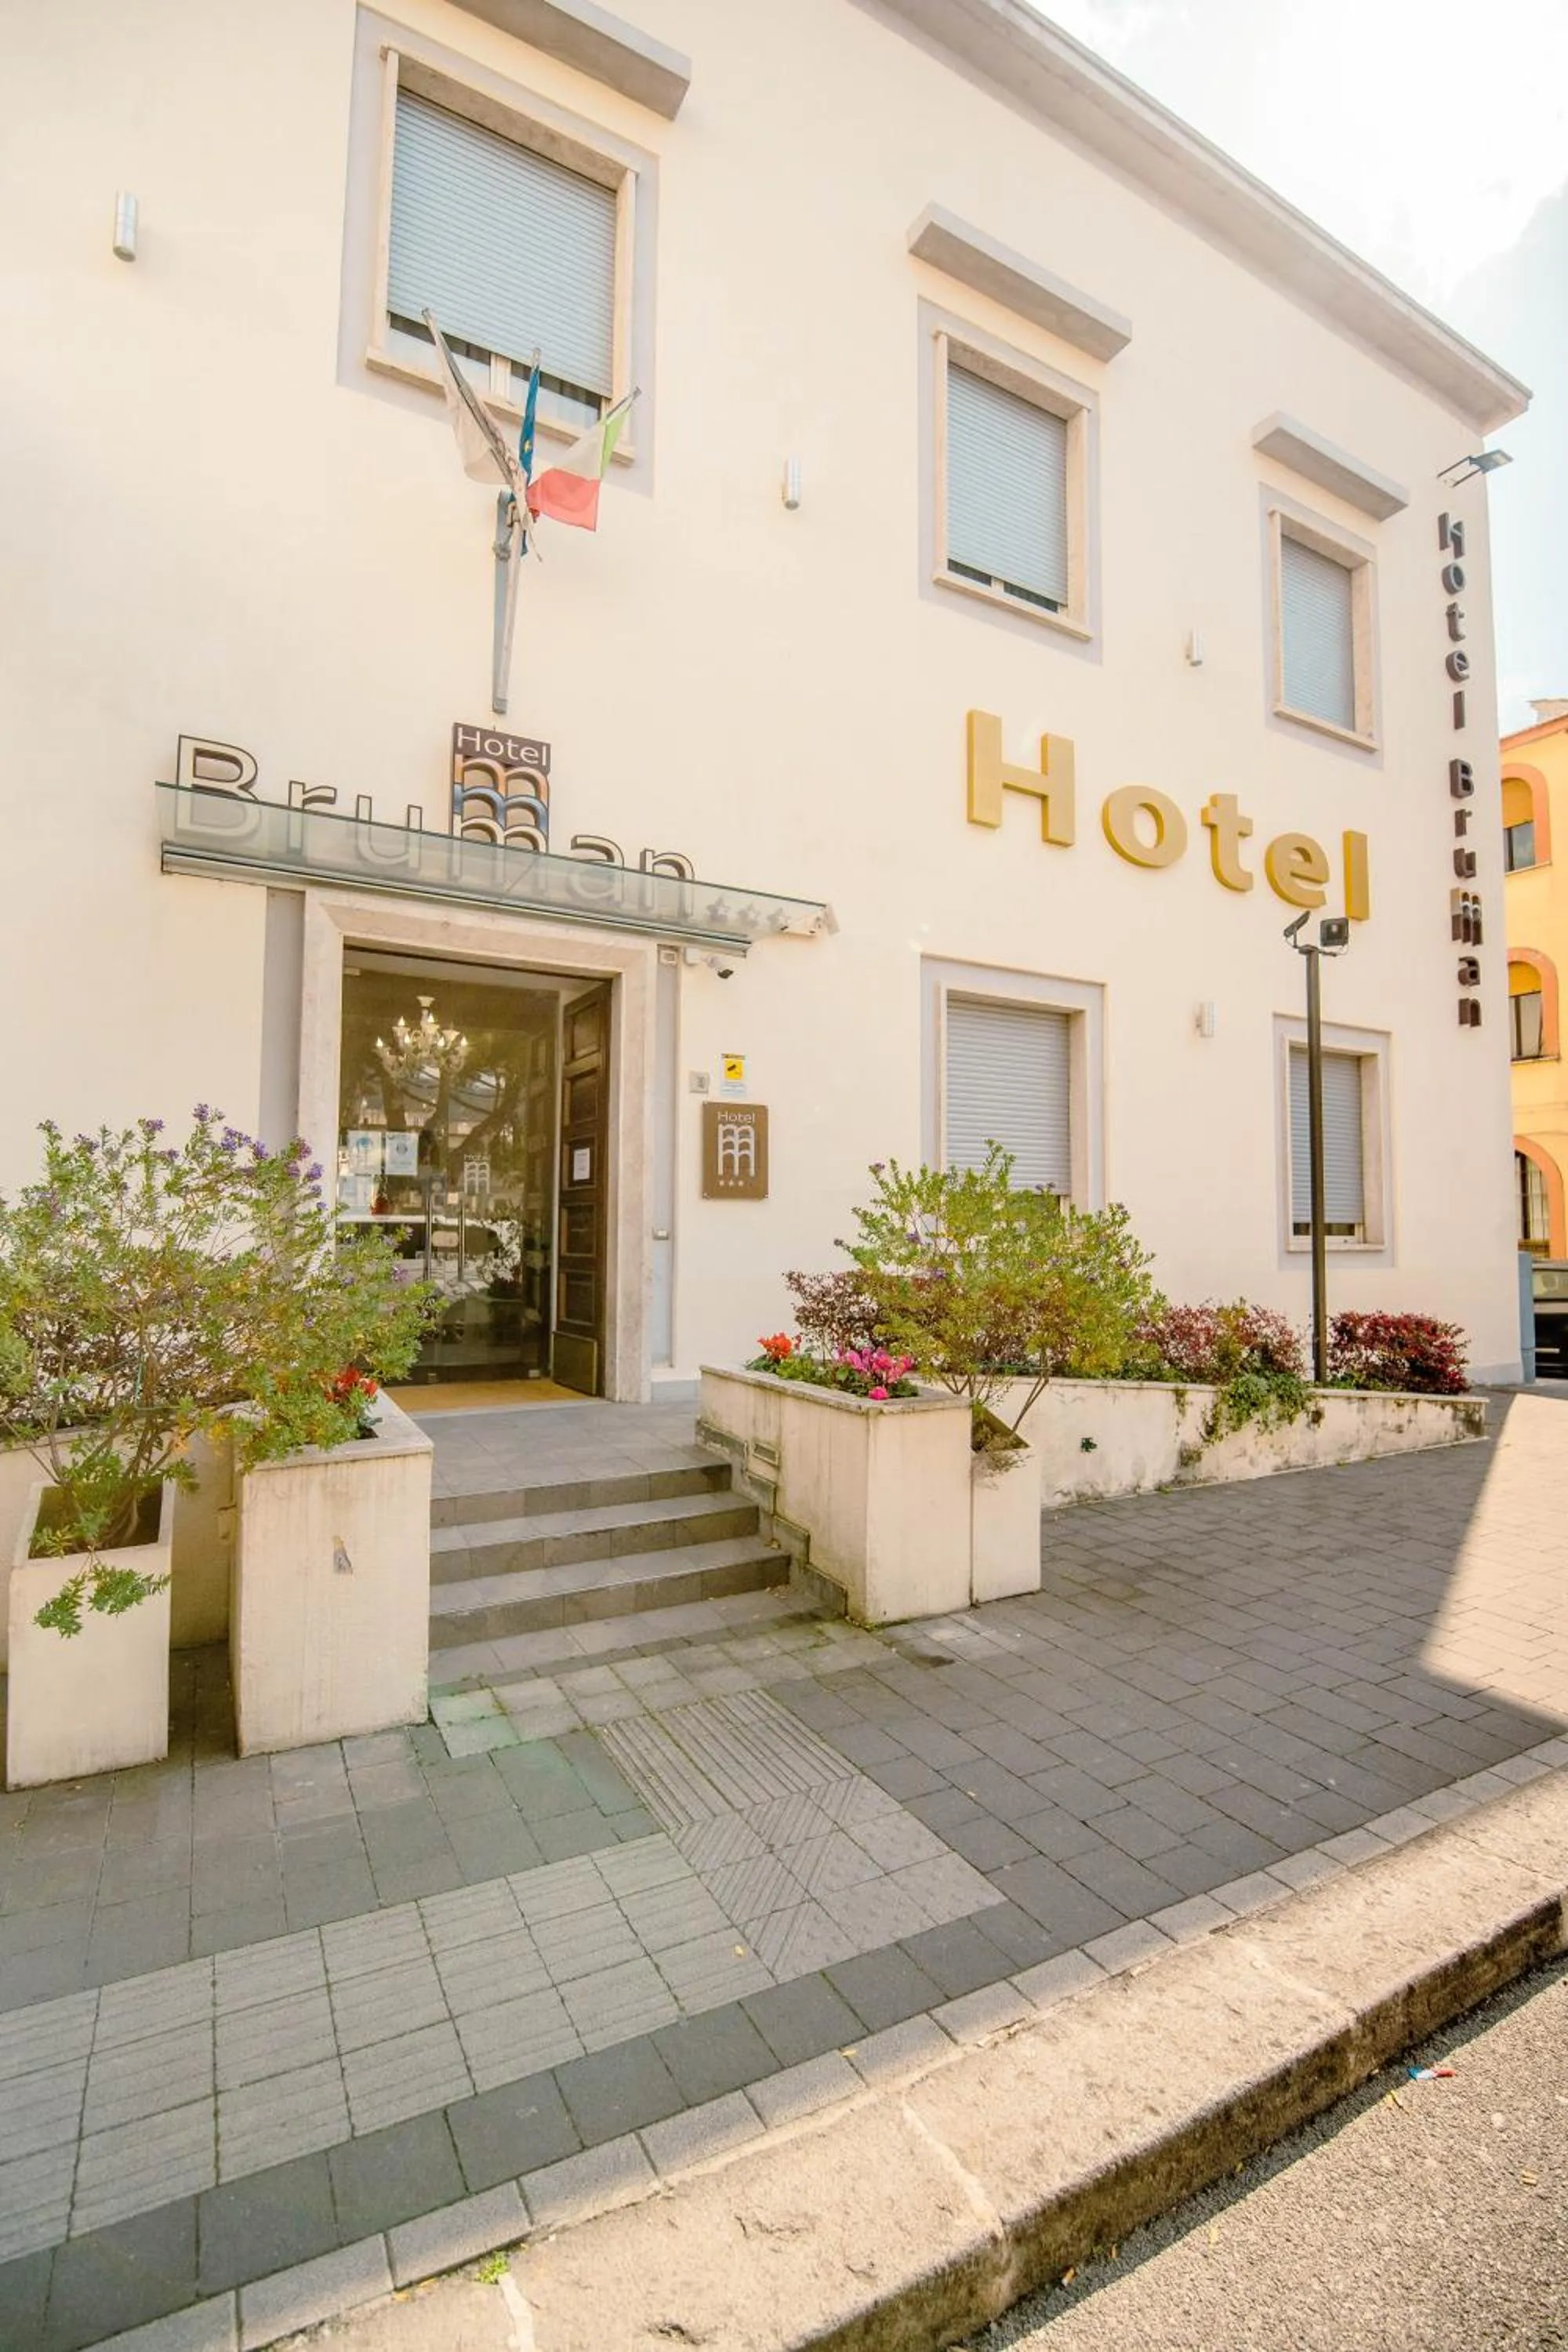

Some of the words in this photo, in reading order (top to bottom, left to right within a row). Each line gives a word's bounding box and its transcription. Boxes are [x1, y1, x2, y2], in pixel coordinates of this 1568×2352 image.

[456, 726, 548, 767] Hotel
[967, 709, 1370, 921] Hotel
[717, 1110, 756, 1124] Hotel
